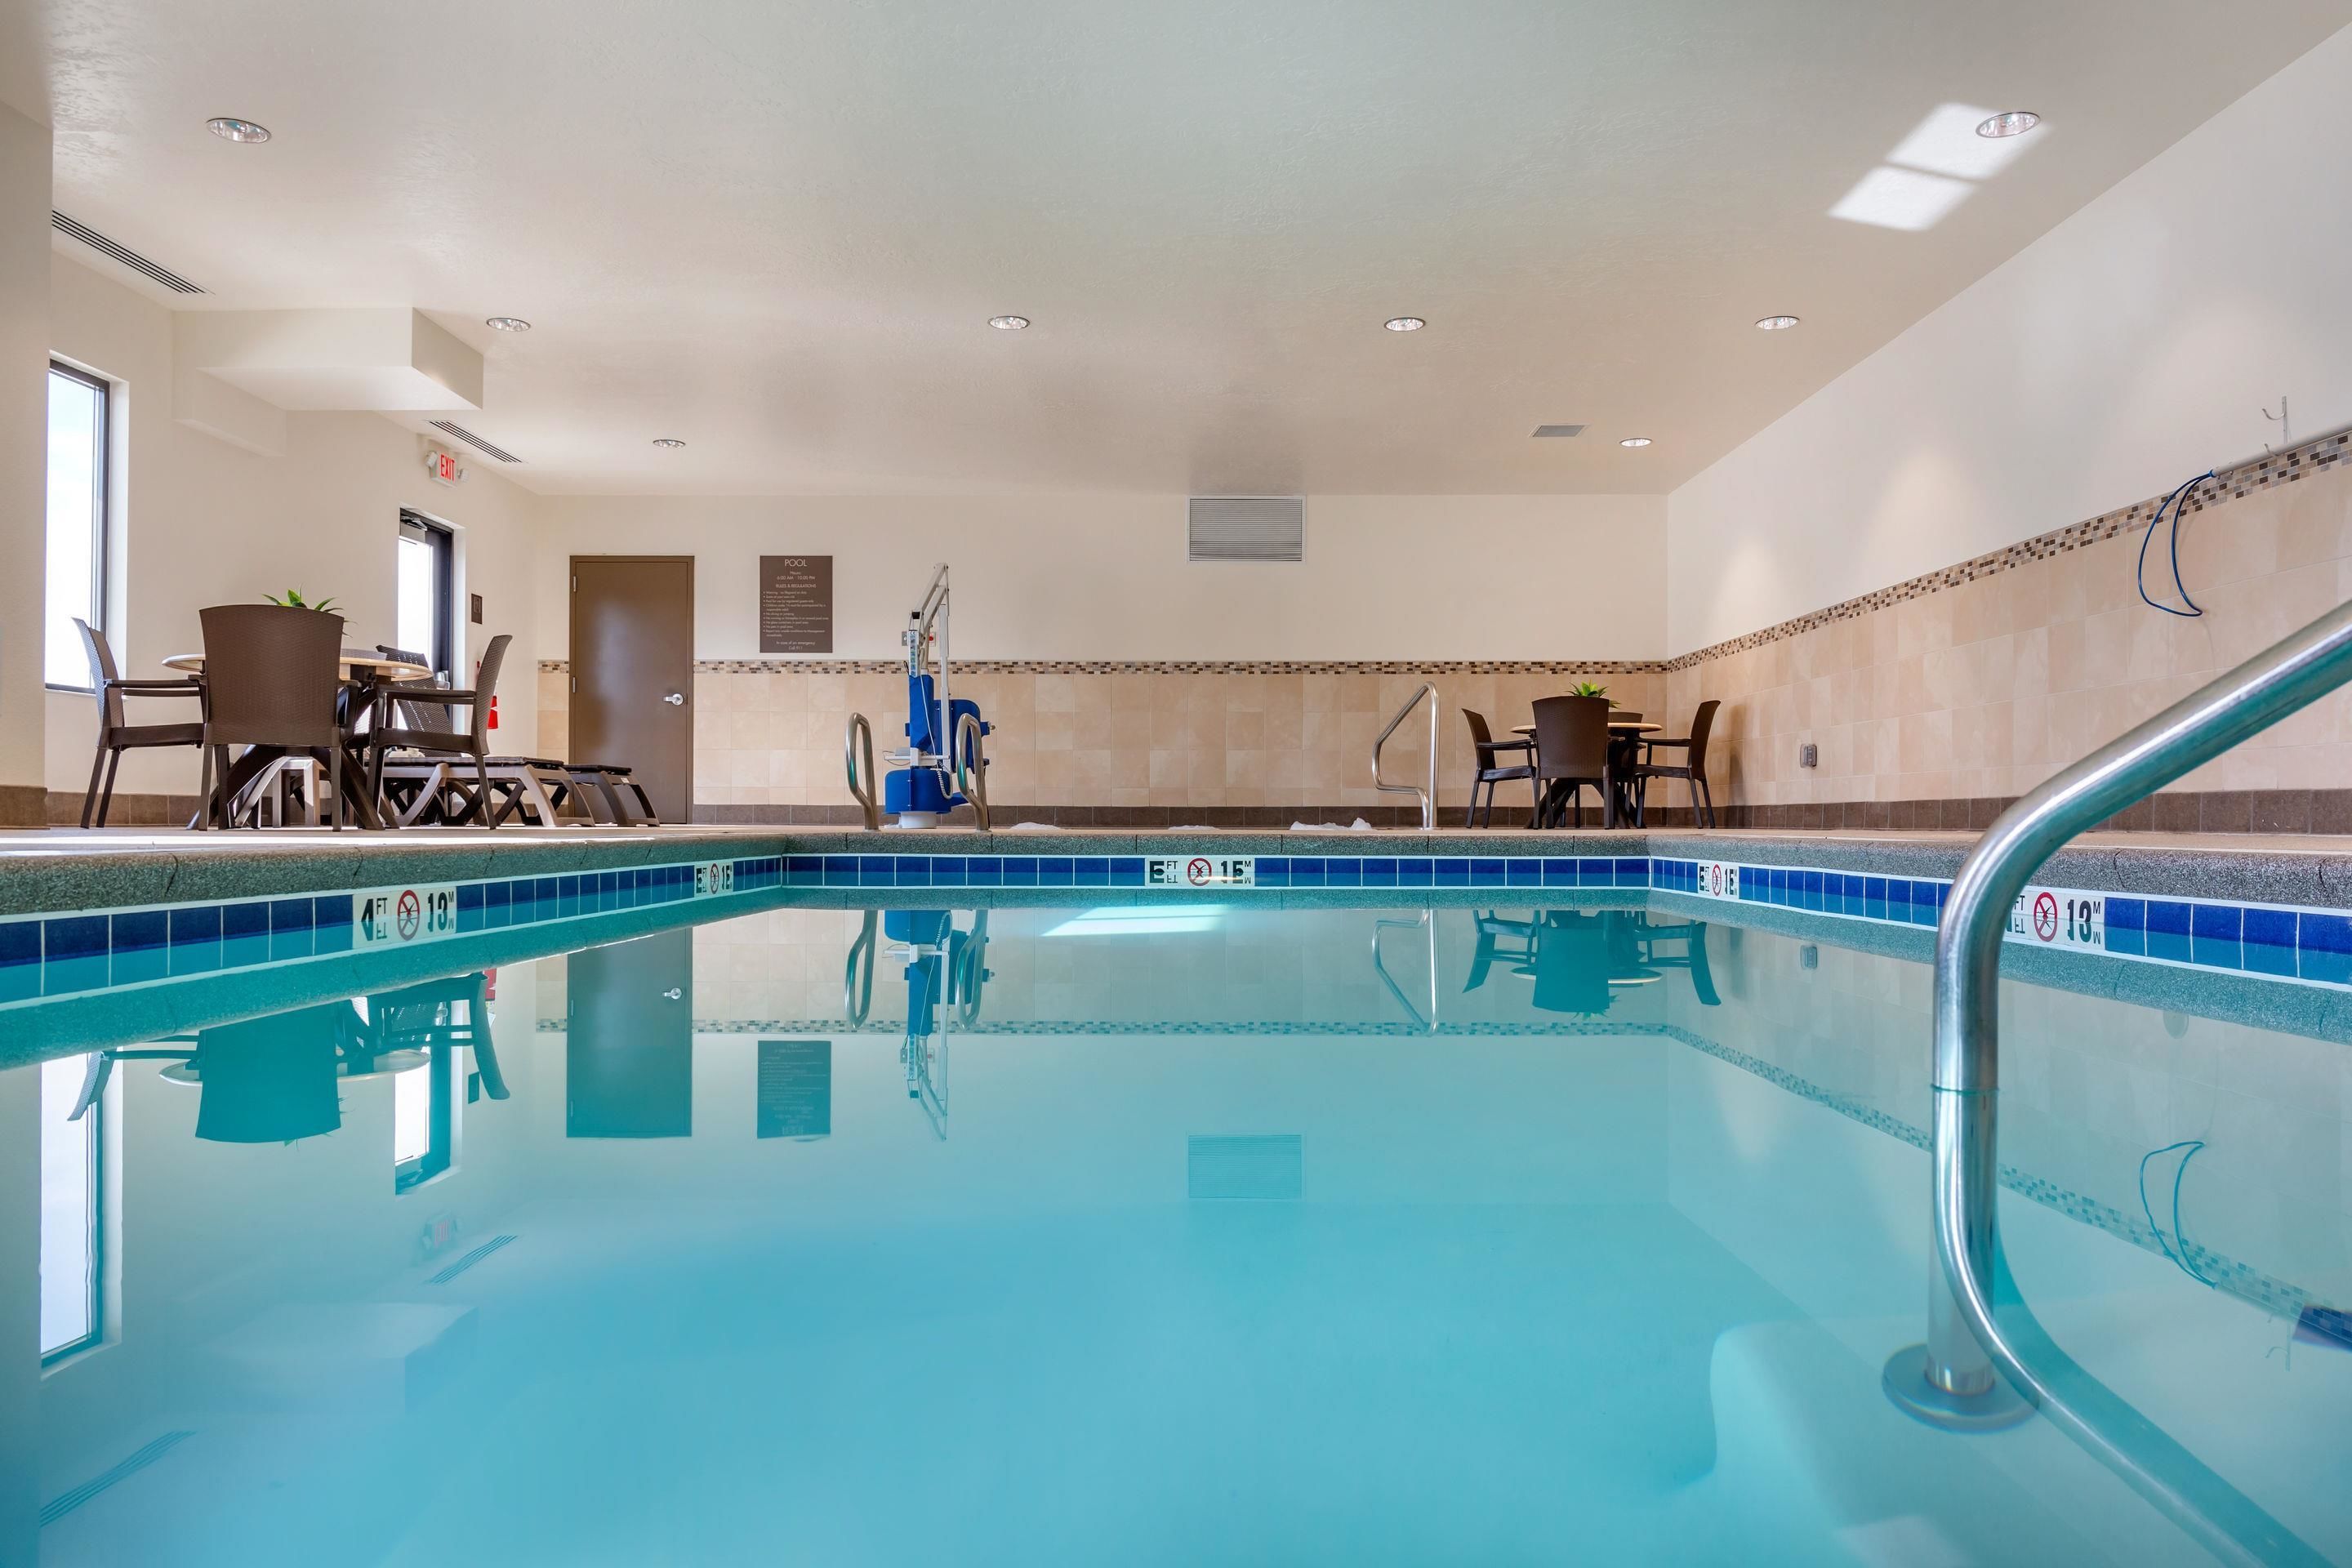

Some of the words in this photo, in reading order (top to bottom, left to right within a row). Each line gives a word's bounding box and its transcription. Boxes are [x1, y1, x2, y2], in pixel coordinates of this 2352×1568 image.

[441, 454, 455, 482] EXIT
[784, 559, 808, 567] POOL
[1166, 861, 1178, 869] FT
[376, 898, 387, 915] FT
[448, 891, 455, 903] M
[2092, 901, 2101, 915] M
